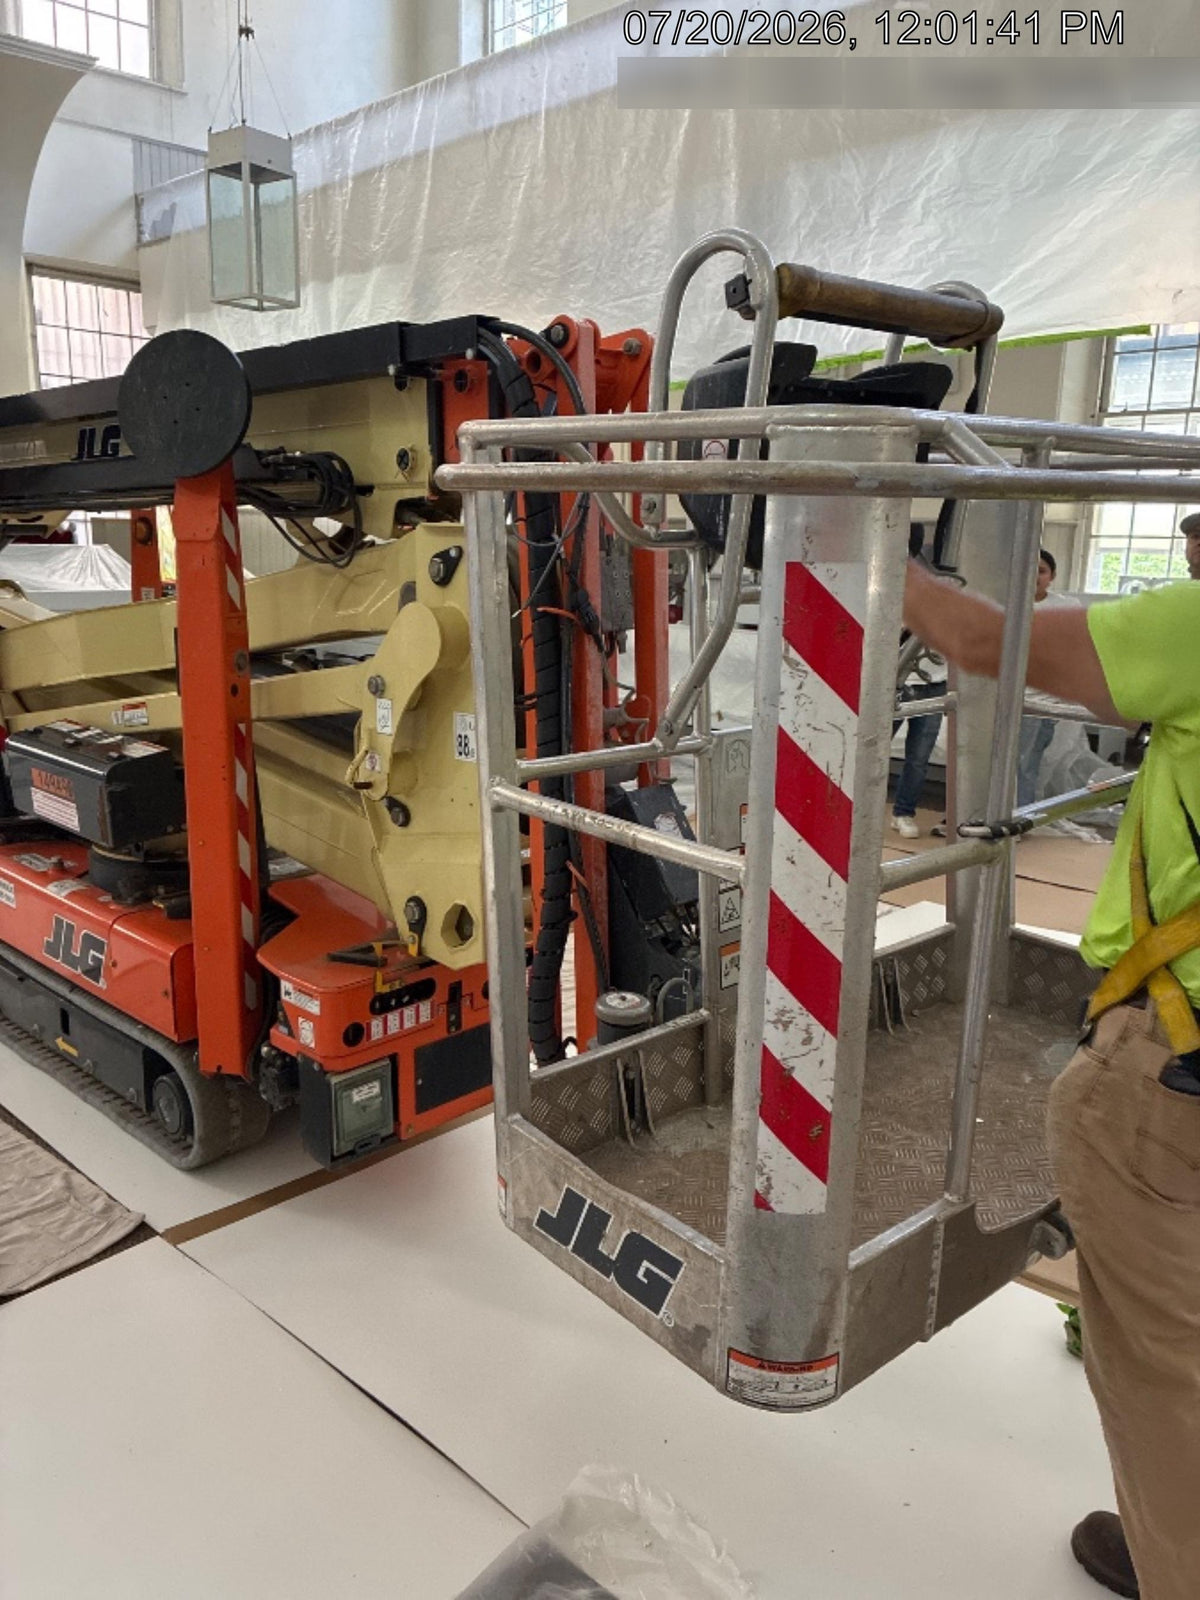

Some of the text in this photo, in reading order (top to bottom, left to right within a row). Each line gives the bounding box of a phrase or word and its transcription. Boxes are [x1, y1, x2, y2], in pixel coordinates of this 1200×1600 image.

[72, 424, 121, 460] JLG
[43, 913, 107, 988] JLG
[533, 1184, 687, 1319] JLG
